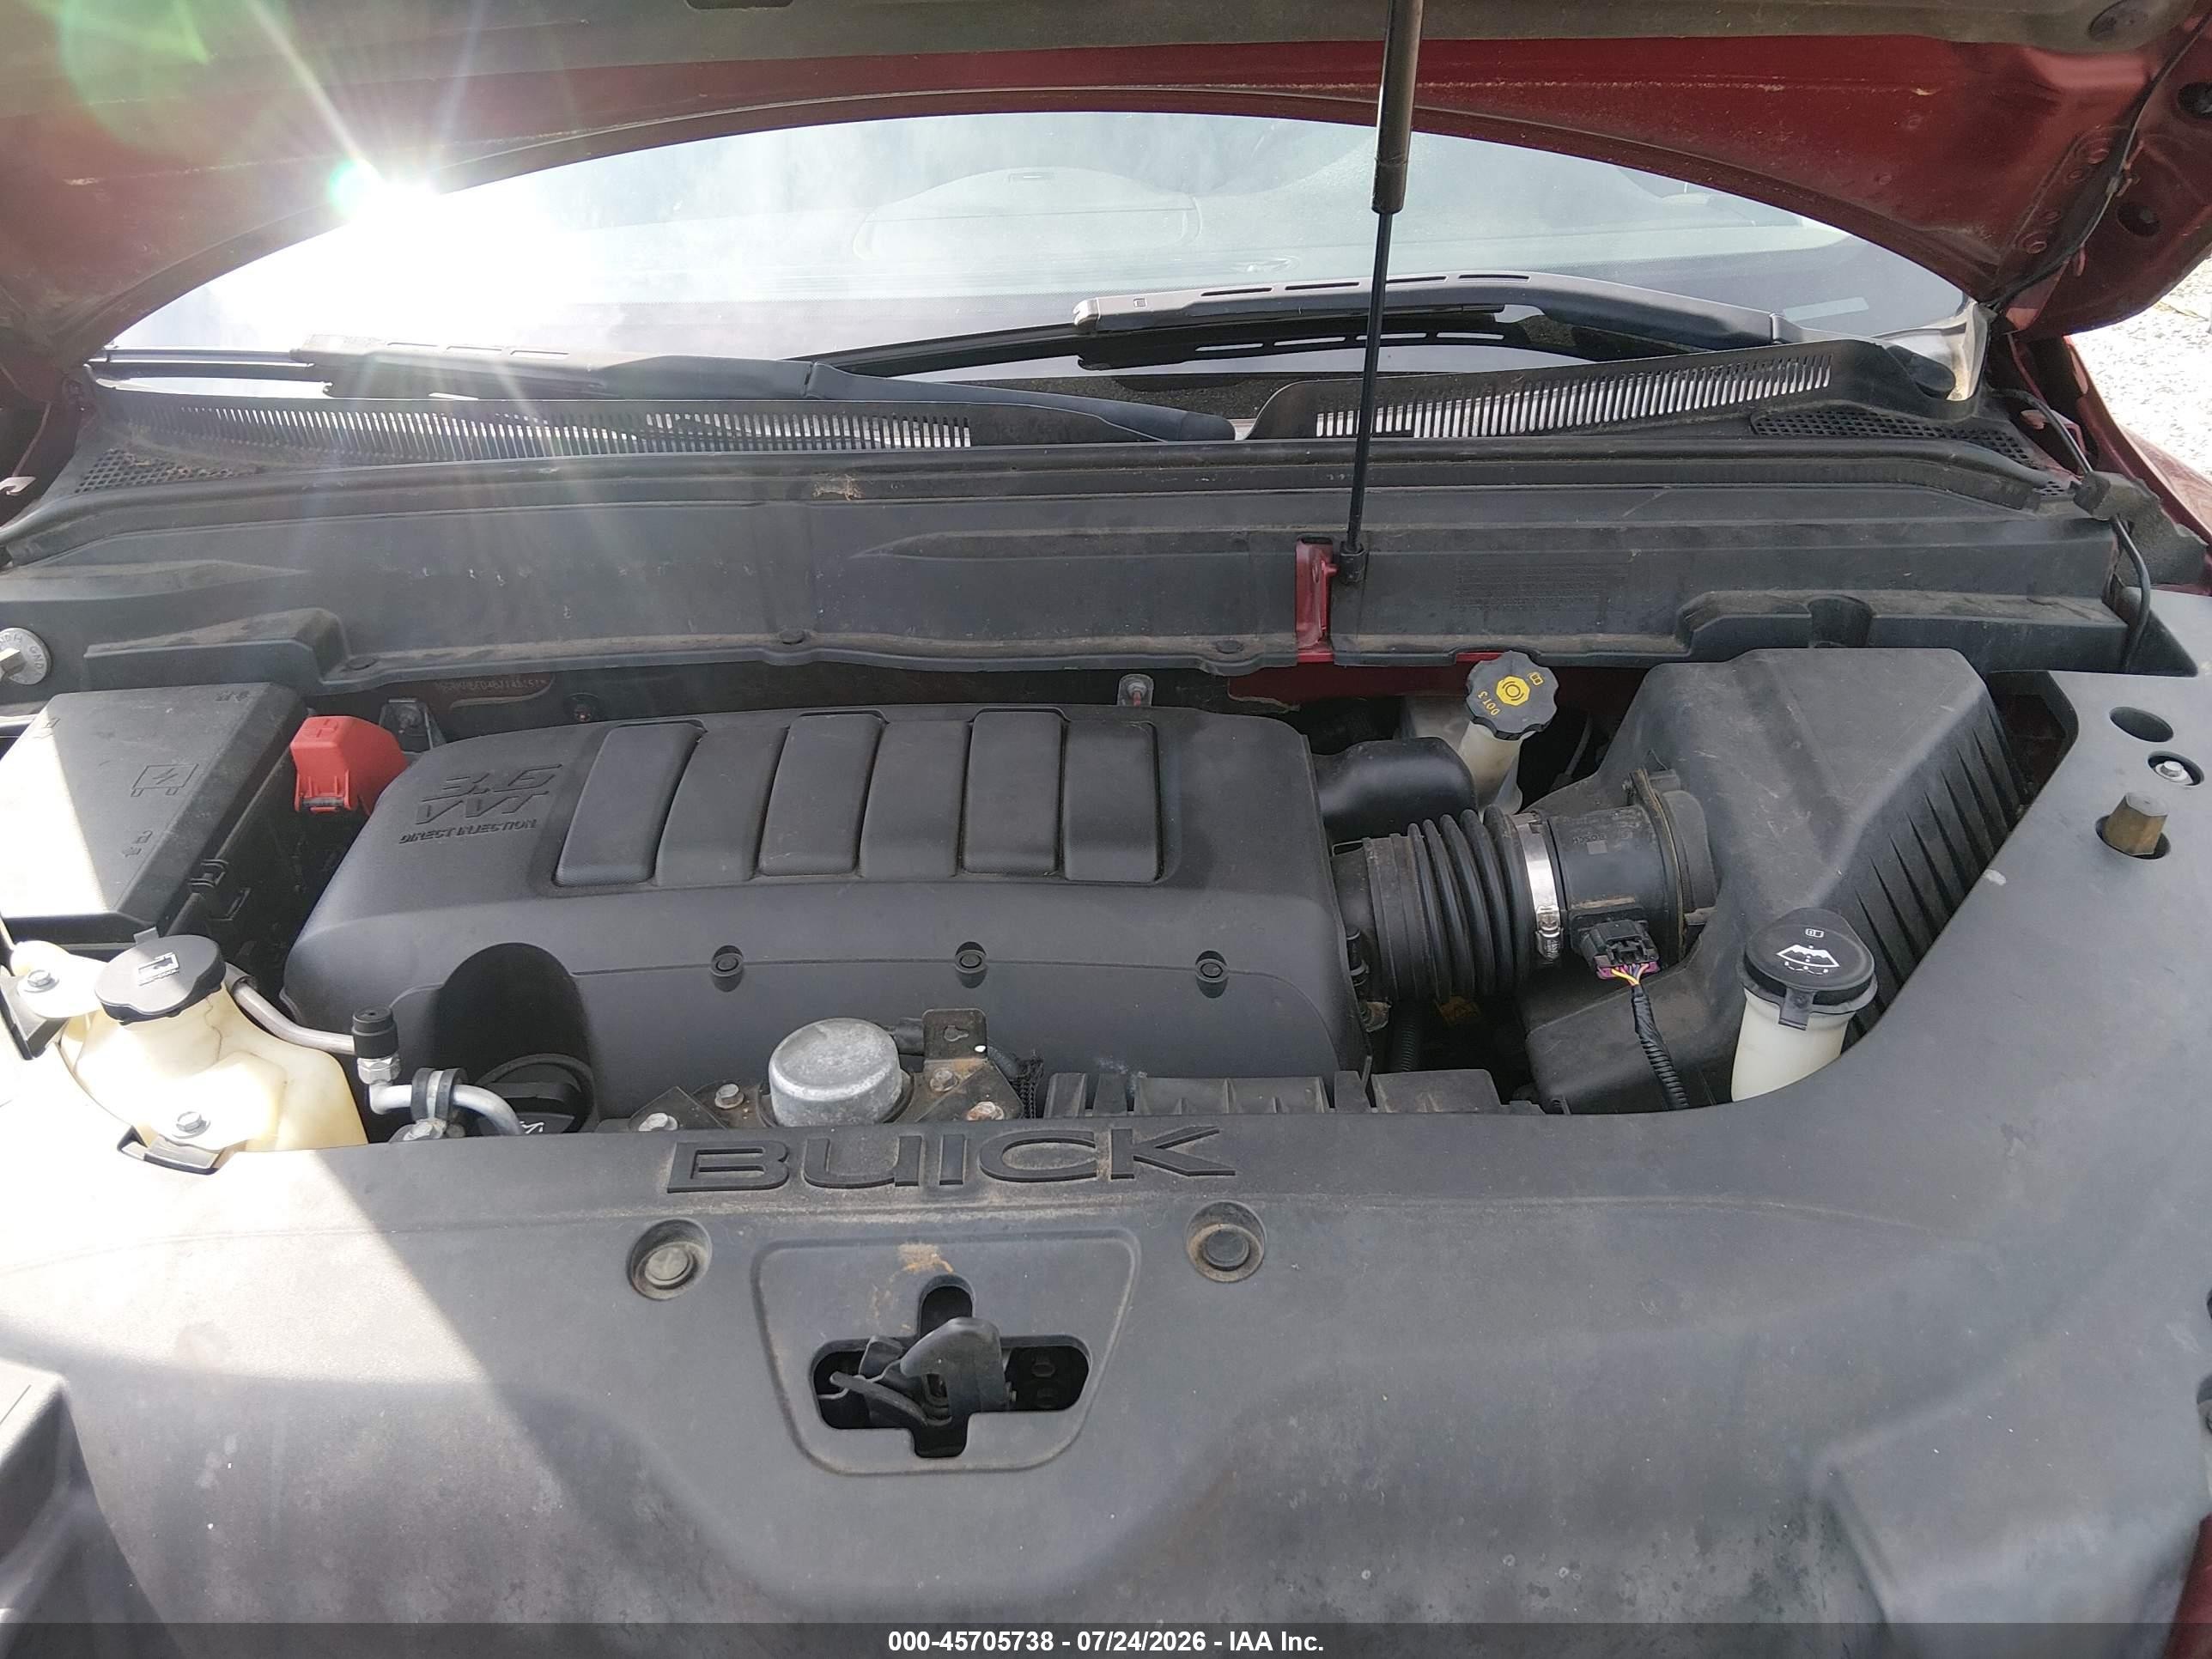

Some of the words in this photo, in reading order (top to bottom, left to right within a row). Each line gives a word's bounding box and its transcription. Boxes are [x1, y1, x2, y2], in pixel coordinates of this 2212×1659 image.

[422, 763, 562, 802] 3.6
[416, 790, 550, 824] VVT
[398, 827, 455, 844] DIRECT
[456, 818, 538, 836] INJECTION
[1572, 833, 1607, 845] BOSCH
[666, 1127, 1236, 1194] BUICK
